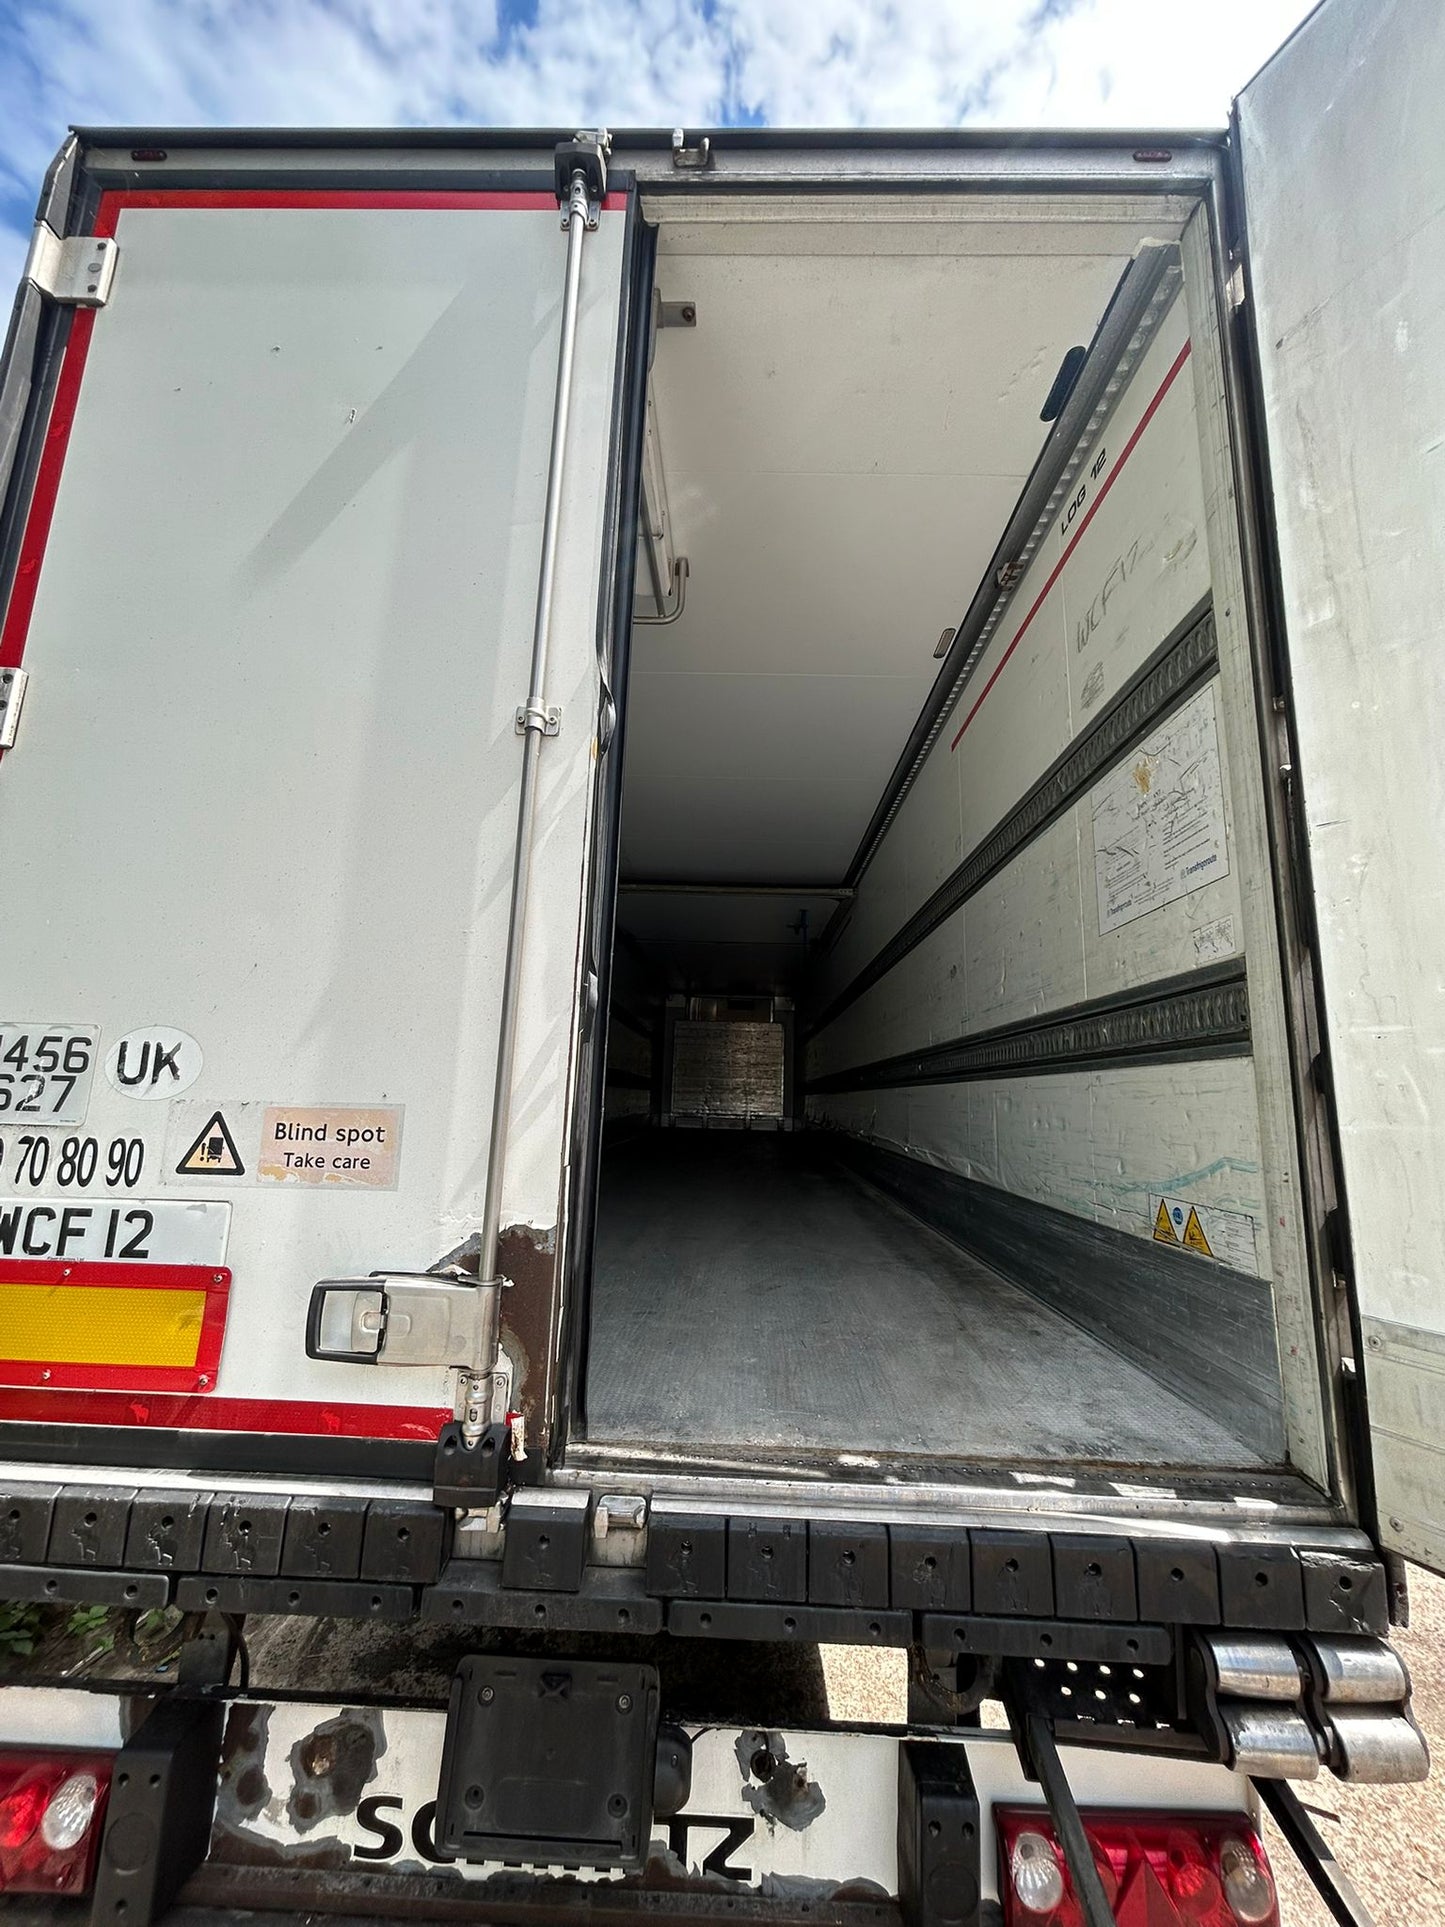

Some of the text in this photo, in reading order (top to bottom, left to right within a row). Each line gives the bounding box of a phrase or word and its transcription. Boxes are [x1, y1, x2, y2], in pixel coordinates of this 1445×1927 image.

[1061, 448, 1107, 536] LOG 12
[0, 1035, 92, 1073] 456
[117, 1041, 182, 1085] UK
[274, 1122, 386, 1146] Blind spot
[15, 1135, 50, 1187] 70
[57, 1137, 98, 1187] 80
[105, 1138, 145, 1187] 90
[283, 1152, 371, 1169] Take care
[0, 1206, 154, 1258] WCF 12
